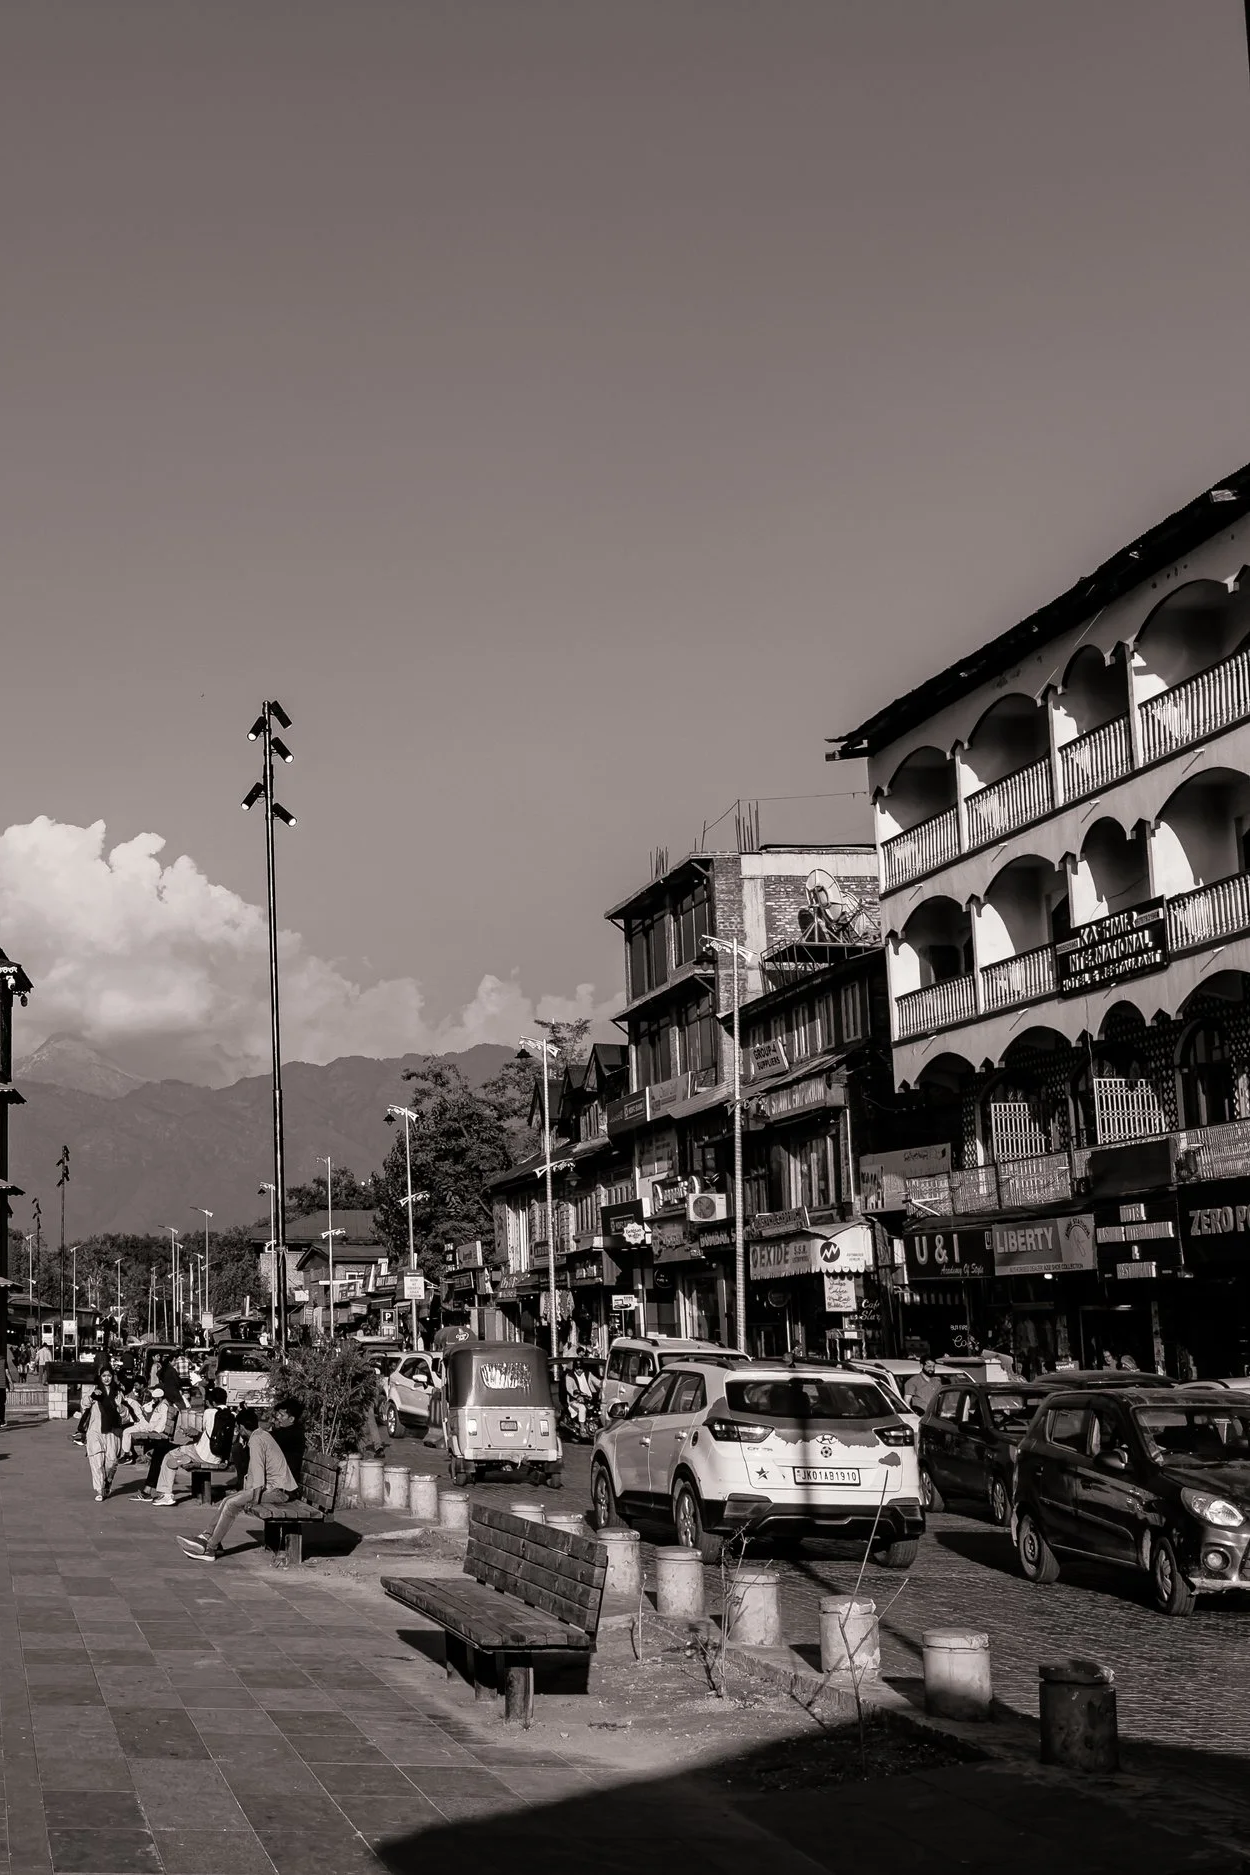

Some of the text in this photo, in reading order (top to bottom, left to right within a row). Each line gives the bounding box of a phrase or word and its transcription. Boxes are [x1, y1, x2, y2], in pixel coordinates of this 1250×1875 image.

[1080, 911, 1138, 947] KASHMIR
[1069, 929, 1153, 973] INTERNATIONAL
[756, 1056, 781, 1071] SUPPLIERS
[1188, 1205, 1235, 1236] ZERO
[914, 1233, 960, 1265] U & I
[996, 1226, 1053, 1254] LIBERTY
[760, 1244, 790, 1268] EXIDE
[385, 1312, 392, 1321] P
[801, 1470, 857, 1482] JK01AB1910
